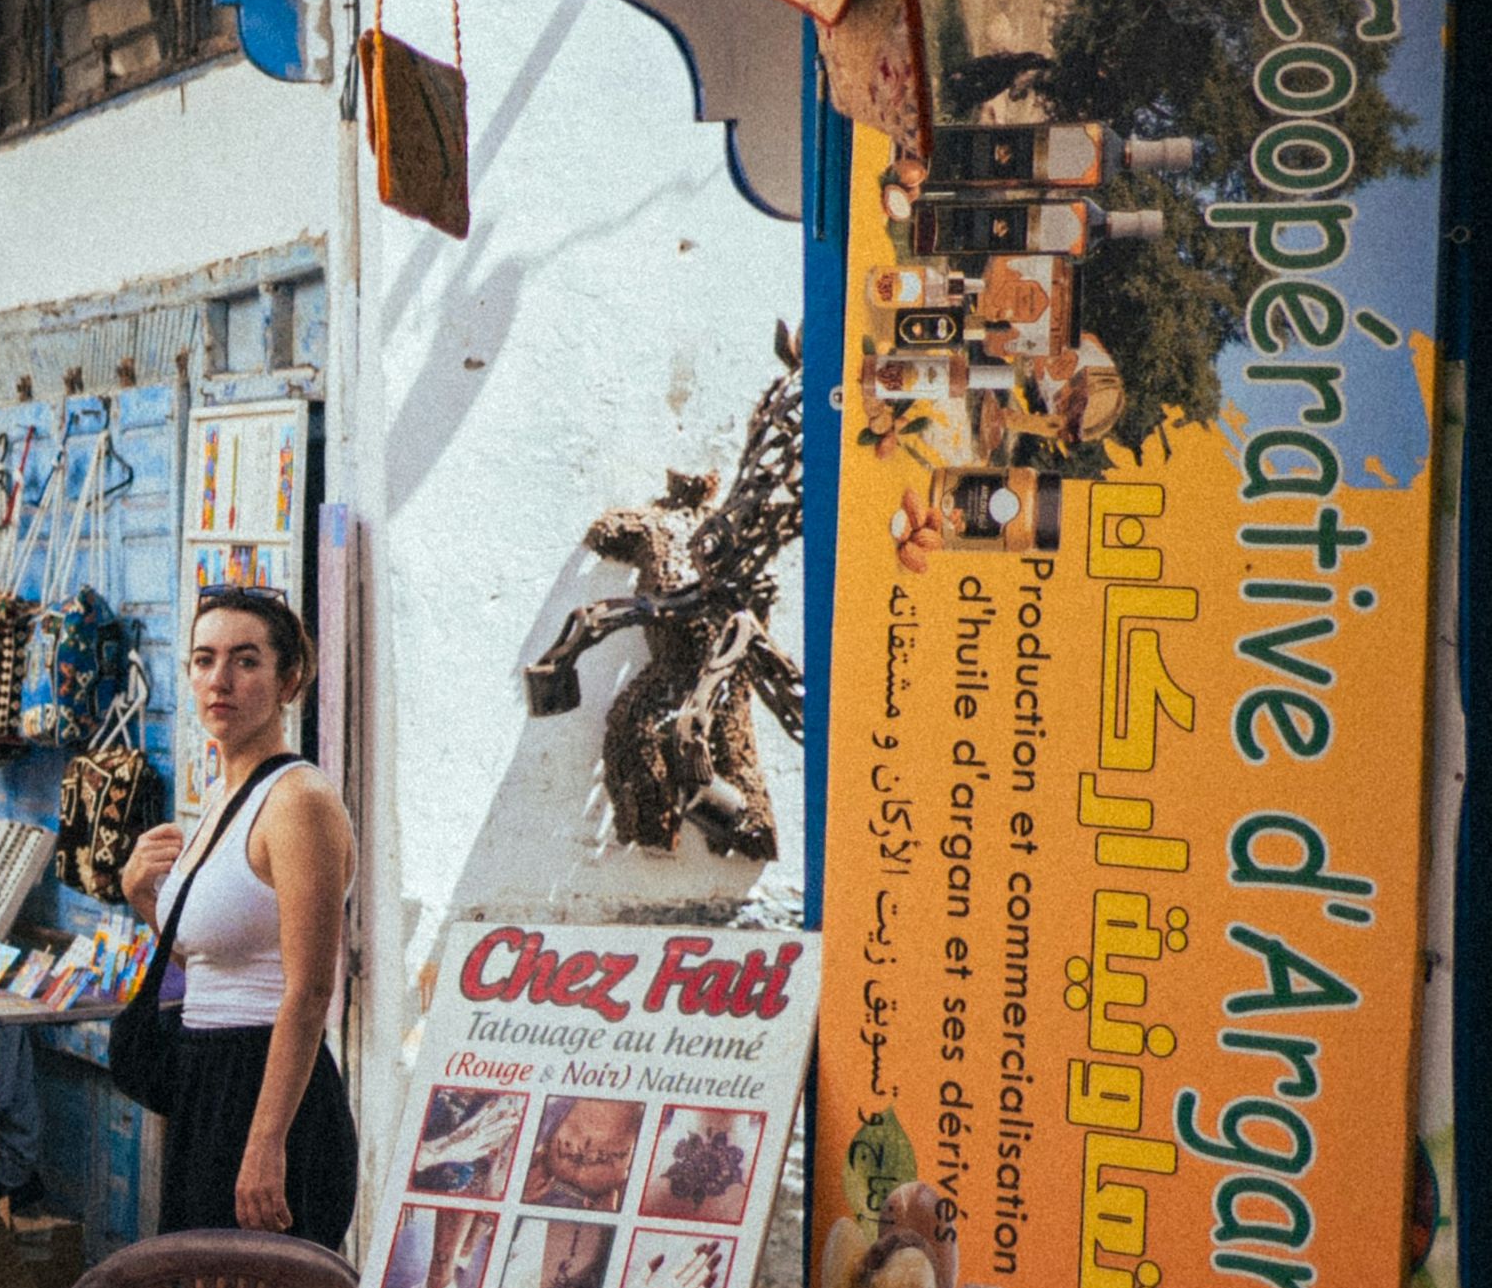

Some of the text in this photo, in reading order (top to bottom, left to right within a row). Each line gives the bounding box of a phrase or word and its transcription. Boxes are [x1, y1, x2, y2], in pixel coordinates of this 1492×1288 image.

[951, 575, 996, 720] d'huile
[940, 740, 990, 918] d'argan
[862, 888, 901, 964] زيت
[946, 937, 972, 979] et
[993, 557, 1054, 1276] Production et commercialisation
[459, 926, 804, 1023] Chez Fati
[444, 1051, 534, 1086] (Rouge
[560, 1061, 632, 1091] Noir)
[636, 1068, 766, 1101] Naturelle
[465, 1011, 769, 1062] Tatouage au henné
[856, 977, 900, 1099] تسويق
[940, 999, 966, 1060] ses
[933, 1081, 973, 1245] dérivés
